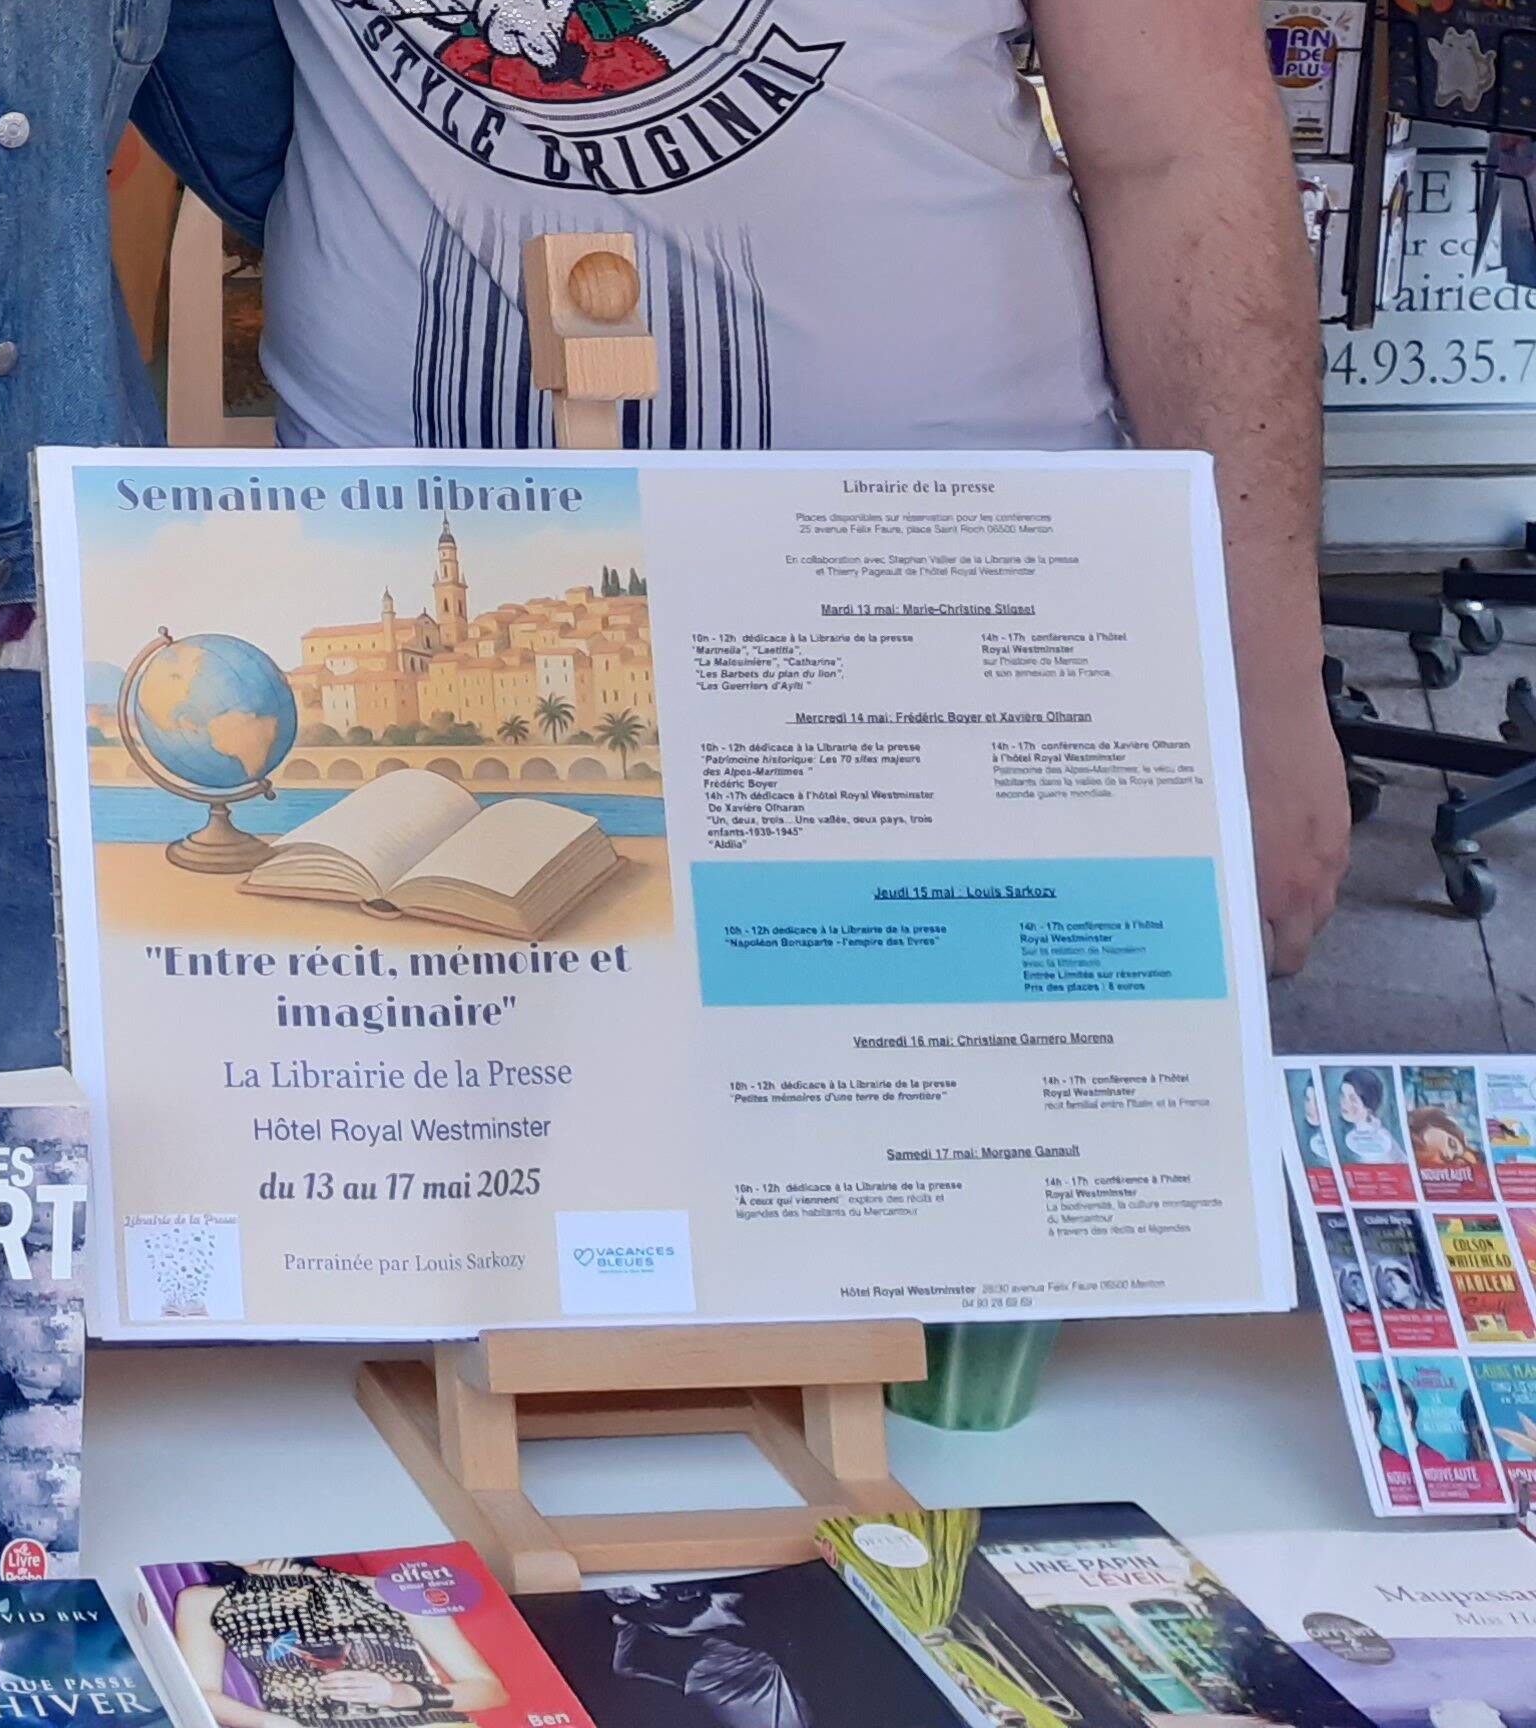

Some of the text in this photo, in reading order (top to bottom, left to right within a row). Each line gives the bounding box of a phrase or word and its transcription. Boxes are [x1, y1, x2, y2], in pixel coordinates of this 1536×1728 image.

[363, 15, 508, 163] STYLE
[117, 475, 582, 514] Semaine du libraire
[844, 480, 995, 496] Librairie de la presse
[822, 604, 854, 616] Mardi
[858, 604, 870, 614] 13
[875, 886, 955, 899] Jeudi 15 mai
[146, 944, 630, 979] "Entre récit, mémoire et
[277, 995, 516, 1034] imaginaire"
[223, 1060, 572, 1088] La Librairie de la Presse
[254, 1116, 551, 1146] Hôtel Royal Westminster
[887, 1148, 931, 1161] Samedi
[935, 1148, 948, 1160] 17
[982, 1146, 1031, 1161] Morgane
[260, 1169, 541, 1200] du 13 au 17 mai 2025
[597, 1245, 674, 1258] VACANCES
[597, 1256, 654, 1267] BLEUES
[283, 1251, 525, 1276] Parrainée par Louis Sarkozy
[840, 1284, 975, 1298] Hôtel Royal Westminster
[1014, 1553, 1161, 1575] LINE PAPIN
[56, 1609, 101, 1624] BRY
